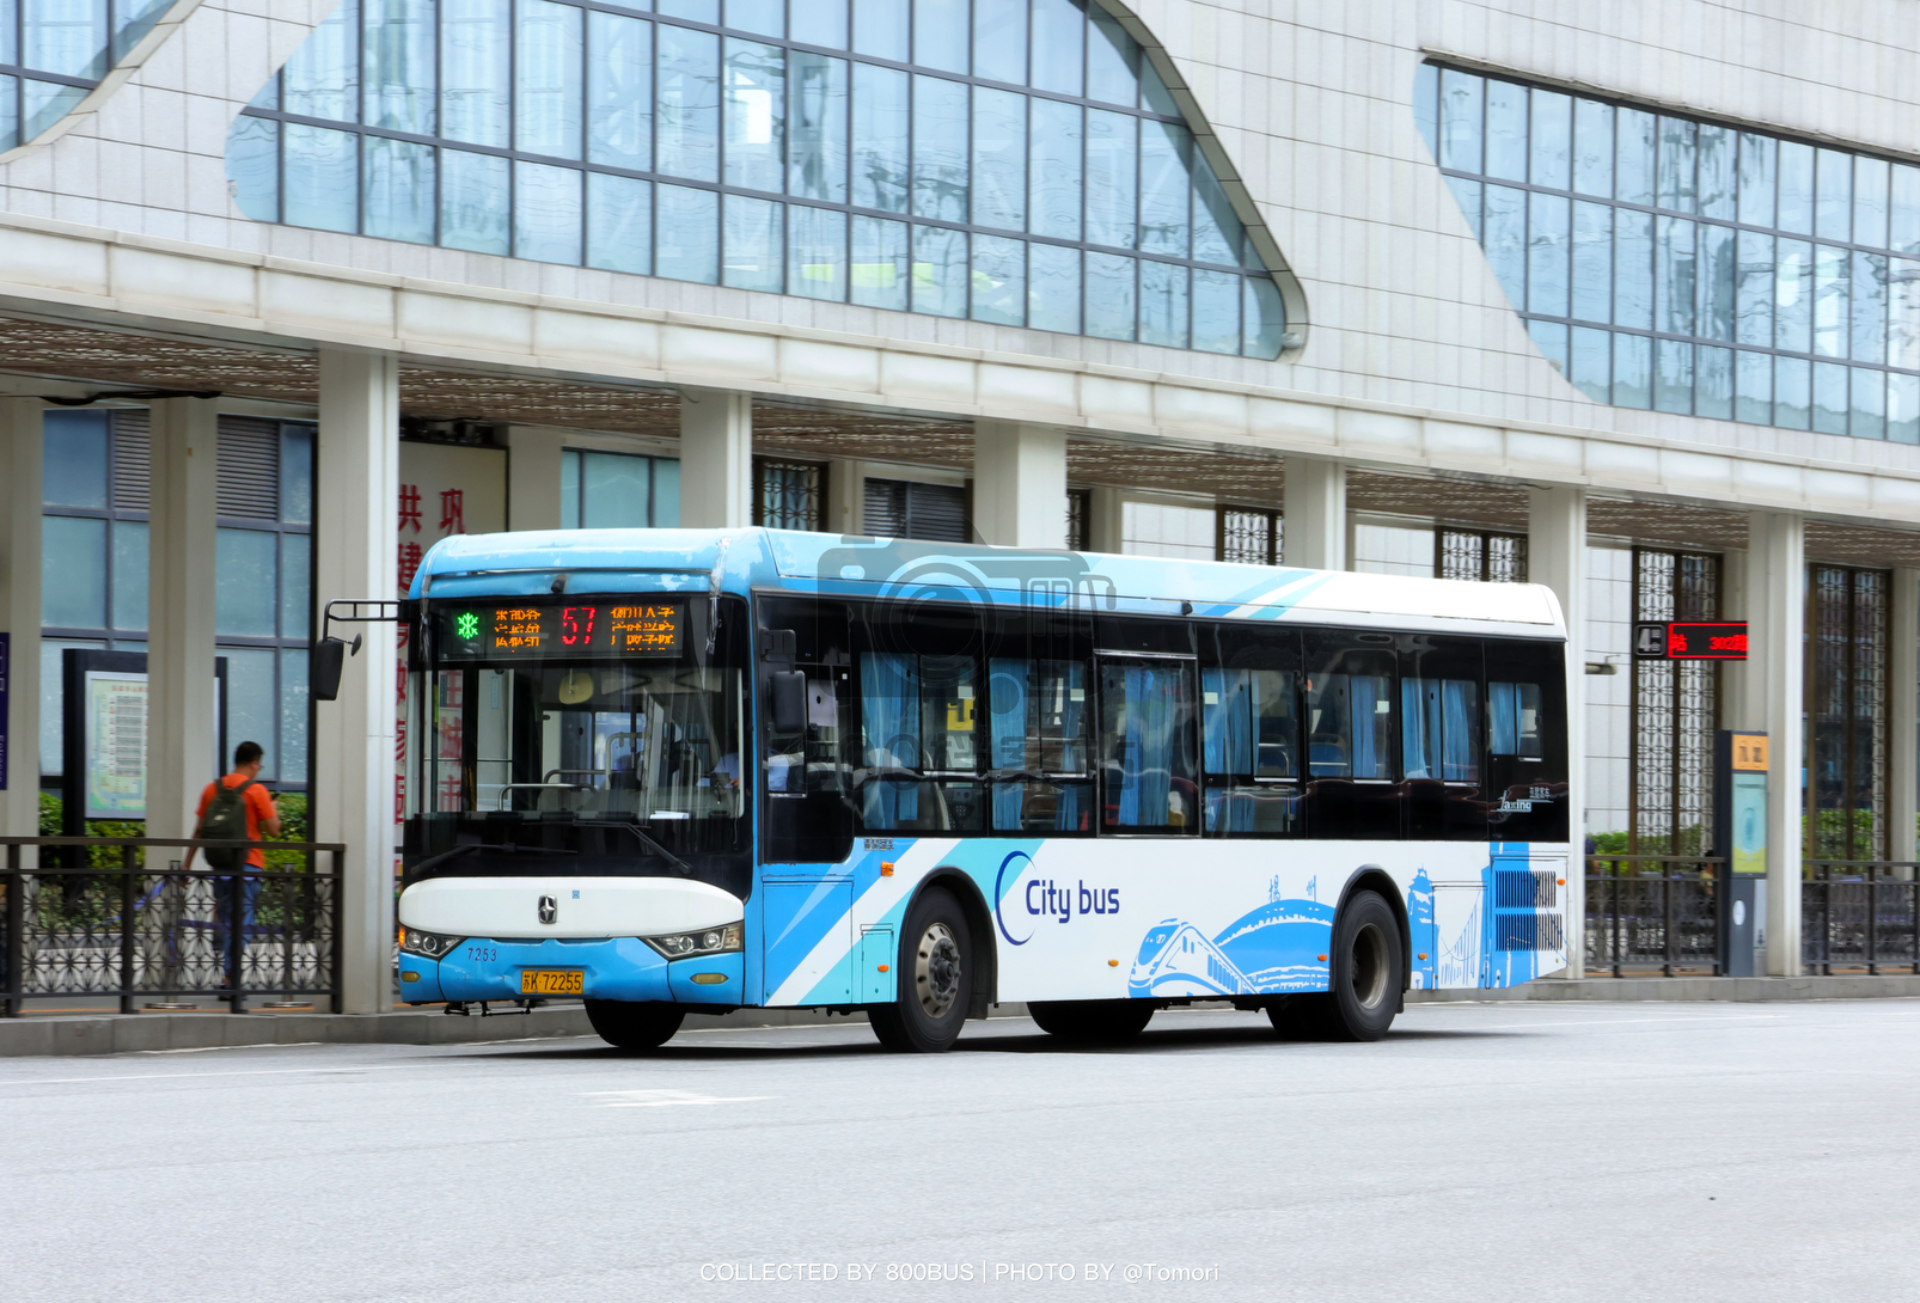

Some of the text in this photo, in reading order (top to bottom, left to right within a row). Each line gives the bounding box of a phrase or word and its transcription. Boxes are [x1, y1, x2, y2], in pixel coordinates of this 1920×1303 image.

[562, 607, 597, 645] 57
[1025, 879, 1120, 924] City bus
[468, 947, 497, 962] 7253
